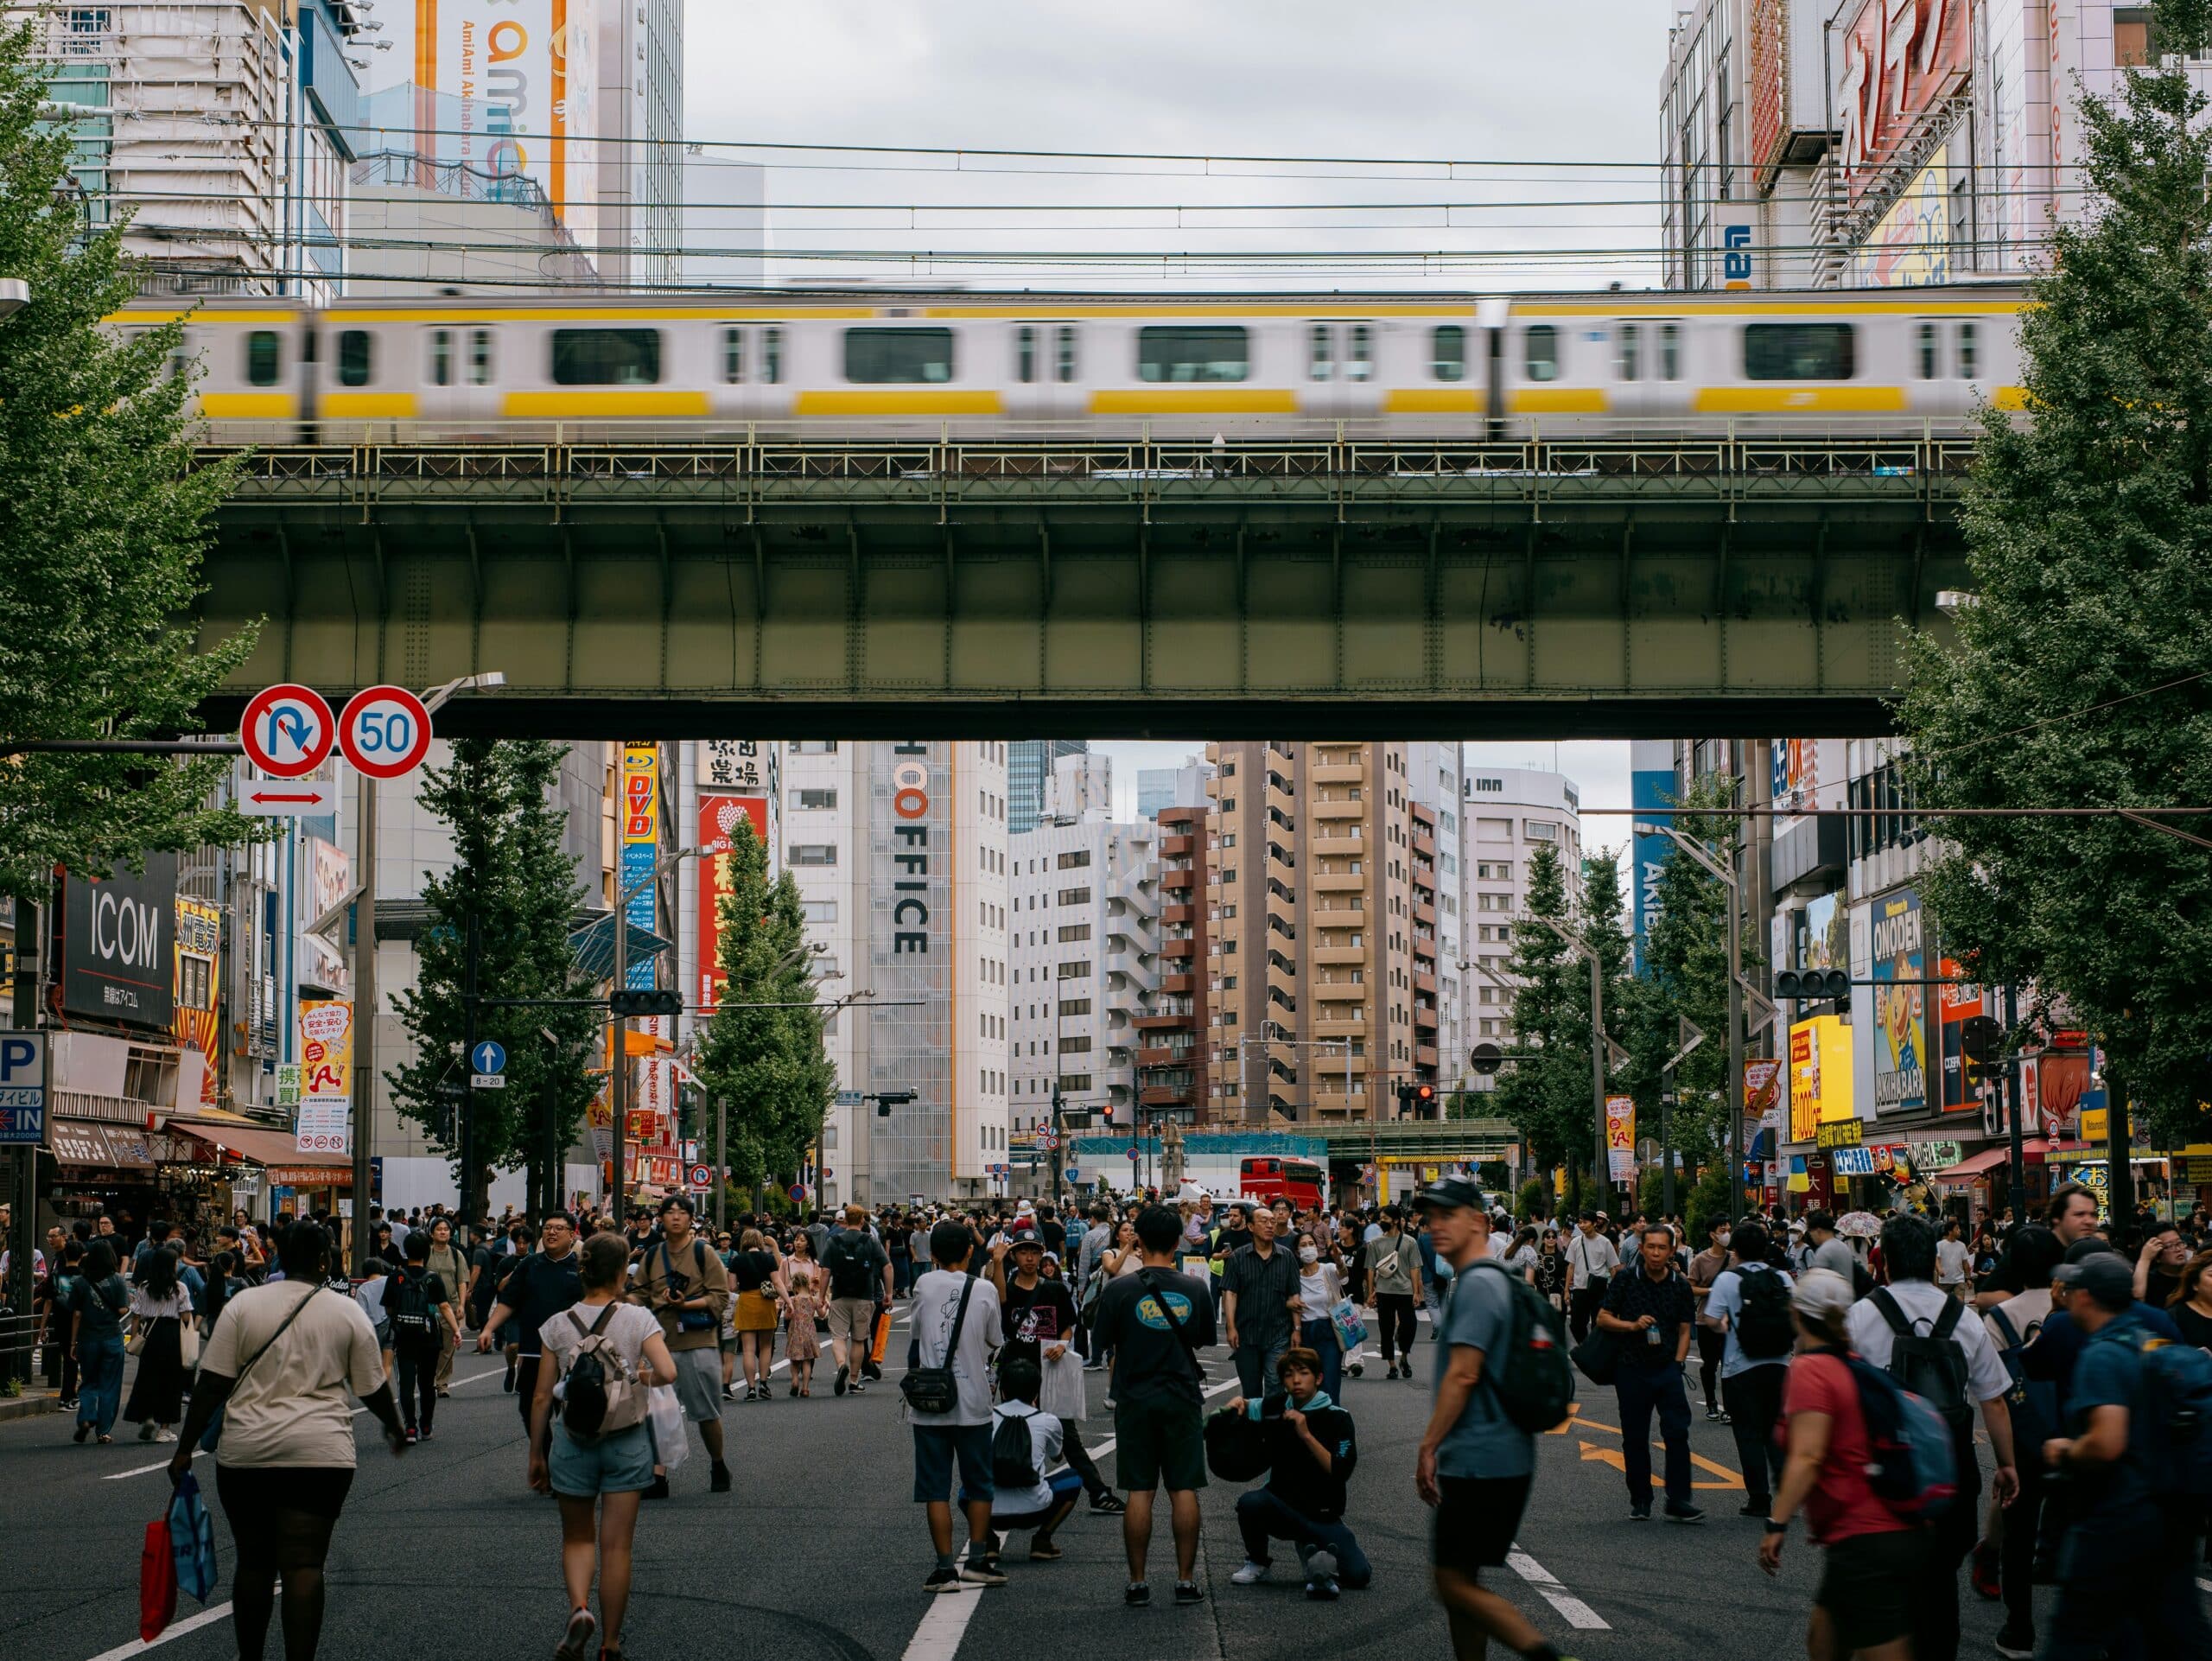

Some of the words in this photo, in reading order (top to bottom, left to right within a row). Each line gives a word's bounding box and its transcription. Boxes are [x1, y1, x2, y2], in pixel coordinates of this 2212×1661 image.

[462, 21, 474, 76] AmiAmi
[461, 80, 474, 156] Akihabara
[360, 712, 410, 753] 50
[627, 775, 654, 837] DVD
[894, 788, 928, 953] OFFICE
[92, 889, 158, 971] ICOM
[1874, 909, 1921, 961] ONODEN
[104, 986, 138, 1008] 無線はアイコム
[308, 1018, 342, 1028] 安全・安心
[2, 1040, 35, 1081] P
[1878, 1067, 1924, 1102] AKIHABARA
[16, 1110, 41, 1130] IN
